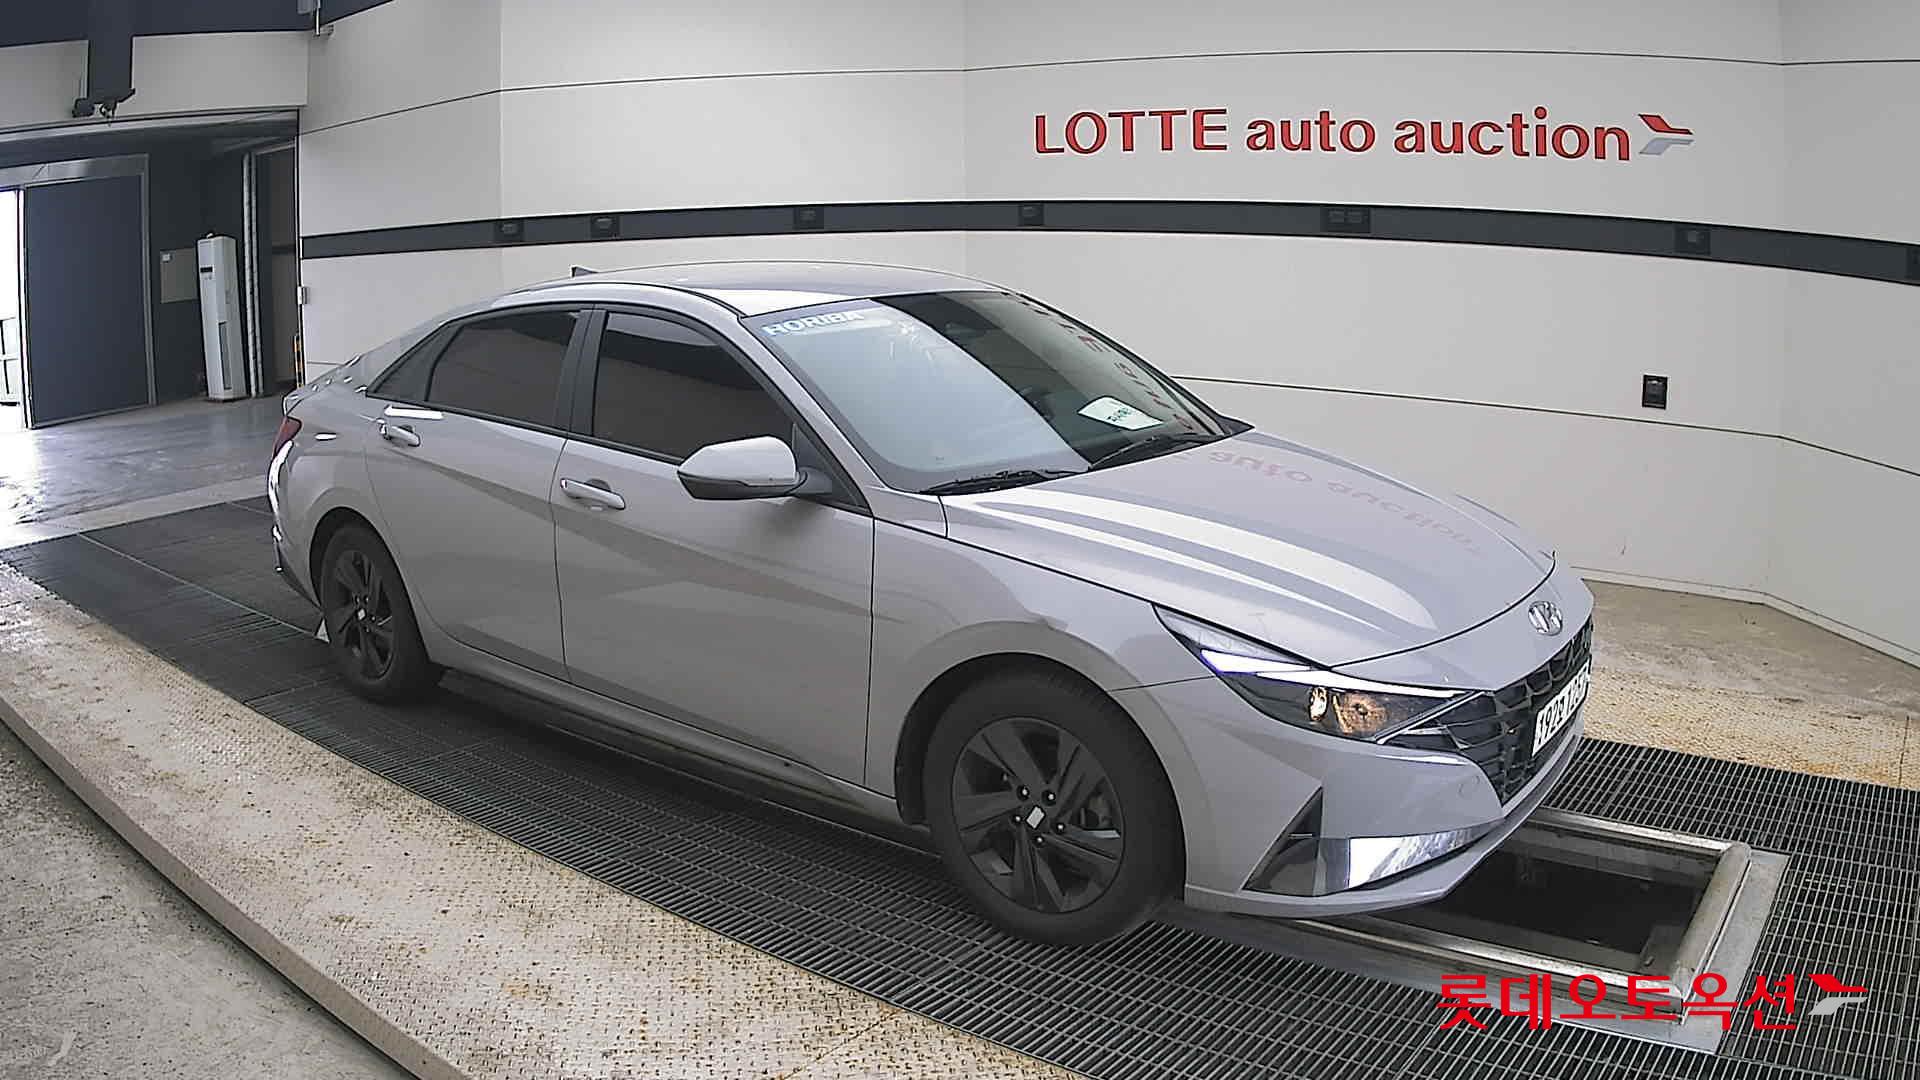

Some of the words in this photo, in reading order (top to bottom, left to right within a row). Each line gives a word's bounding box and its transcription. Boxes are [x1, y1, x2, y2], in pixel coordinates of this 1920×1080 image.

[1034, 108, 1228, 155] LOTTE
[1246, 110, 1376, 154] auto
[1394, 106, 1631, 162] auction
[762, 310, 865, 337] HORIBA
